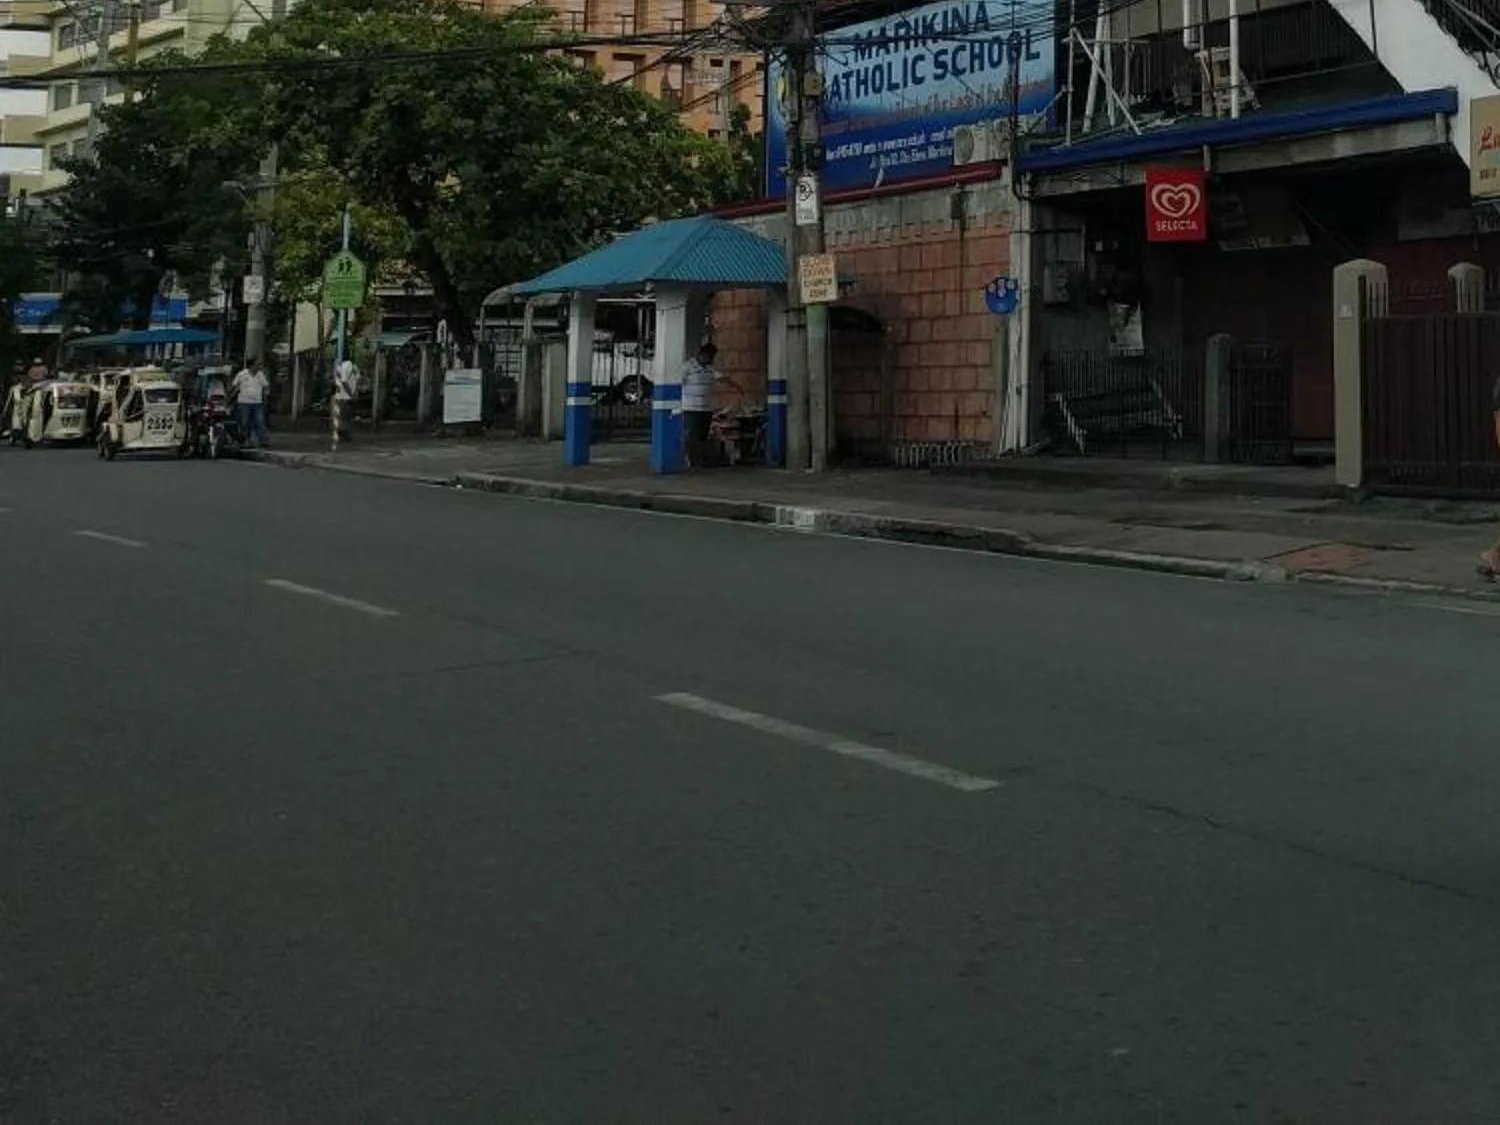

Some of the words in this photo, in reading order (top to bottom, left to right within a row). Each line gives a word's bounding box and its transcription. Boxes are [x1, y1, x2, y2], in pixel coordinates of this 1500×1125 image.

[852, 0, 989, 62] MARIKINA
[823, 54, 926, 105] ATHOLIC
[1155, 220, 1198, 232] SELECTA
